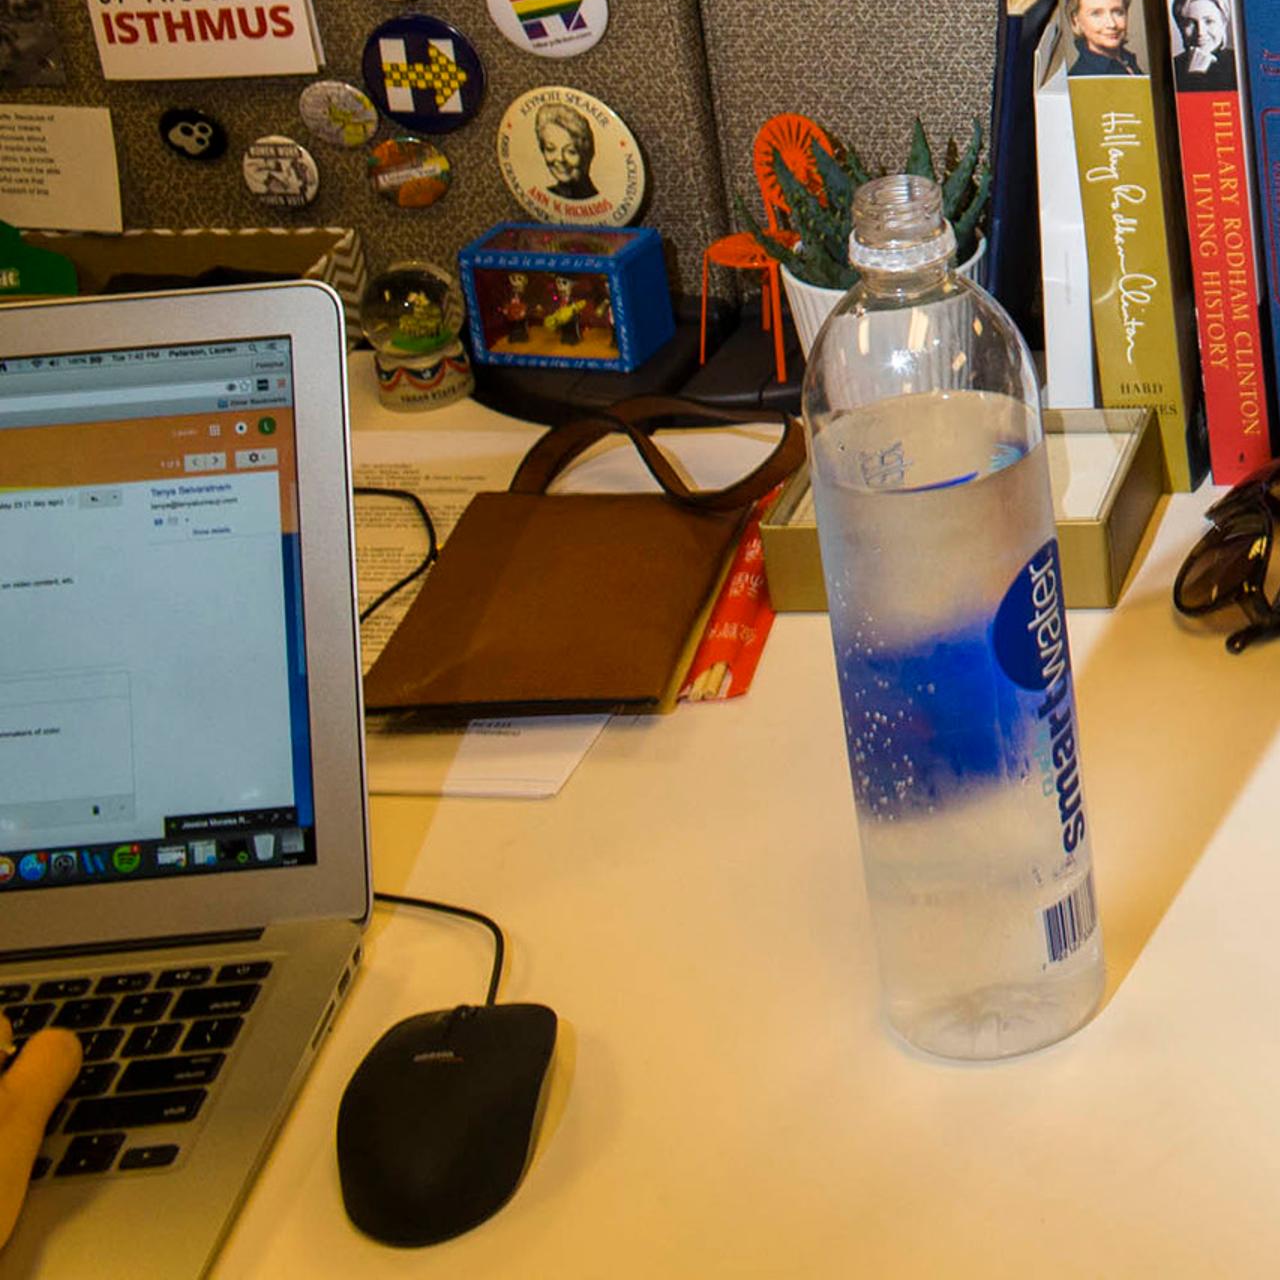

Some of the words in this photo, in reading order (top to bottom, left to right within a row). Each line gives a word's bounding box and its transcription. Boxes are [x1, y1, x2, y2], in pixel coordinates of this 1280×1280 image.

[101, 4, 295, 45] ISTHMUS
[565, 92, 609, 128] SPEAKER
[1212, 101, 1240, 203] HILLARY
[528, 185, 549, 205] ANN
[565, 198, 613, 217] RICHARDS
[612, 153, 637, 221] CONVENTION
[1192, 173, 1219, 257] LIVING
[1224, 217, 1250, 322] RODHAM
[1117, 273, 1157, 365] Clinton
[1202, 272, 1229, 370] HISTORY
[1120, 383, 1164, 396] HARD
[1235, 329, 1261, 436] CLINTON
